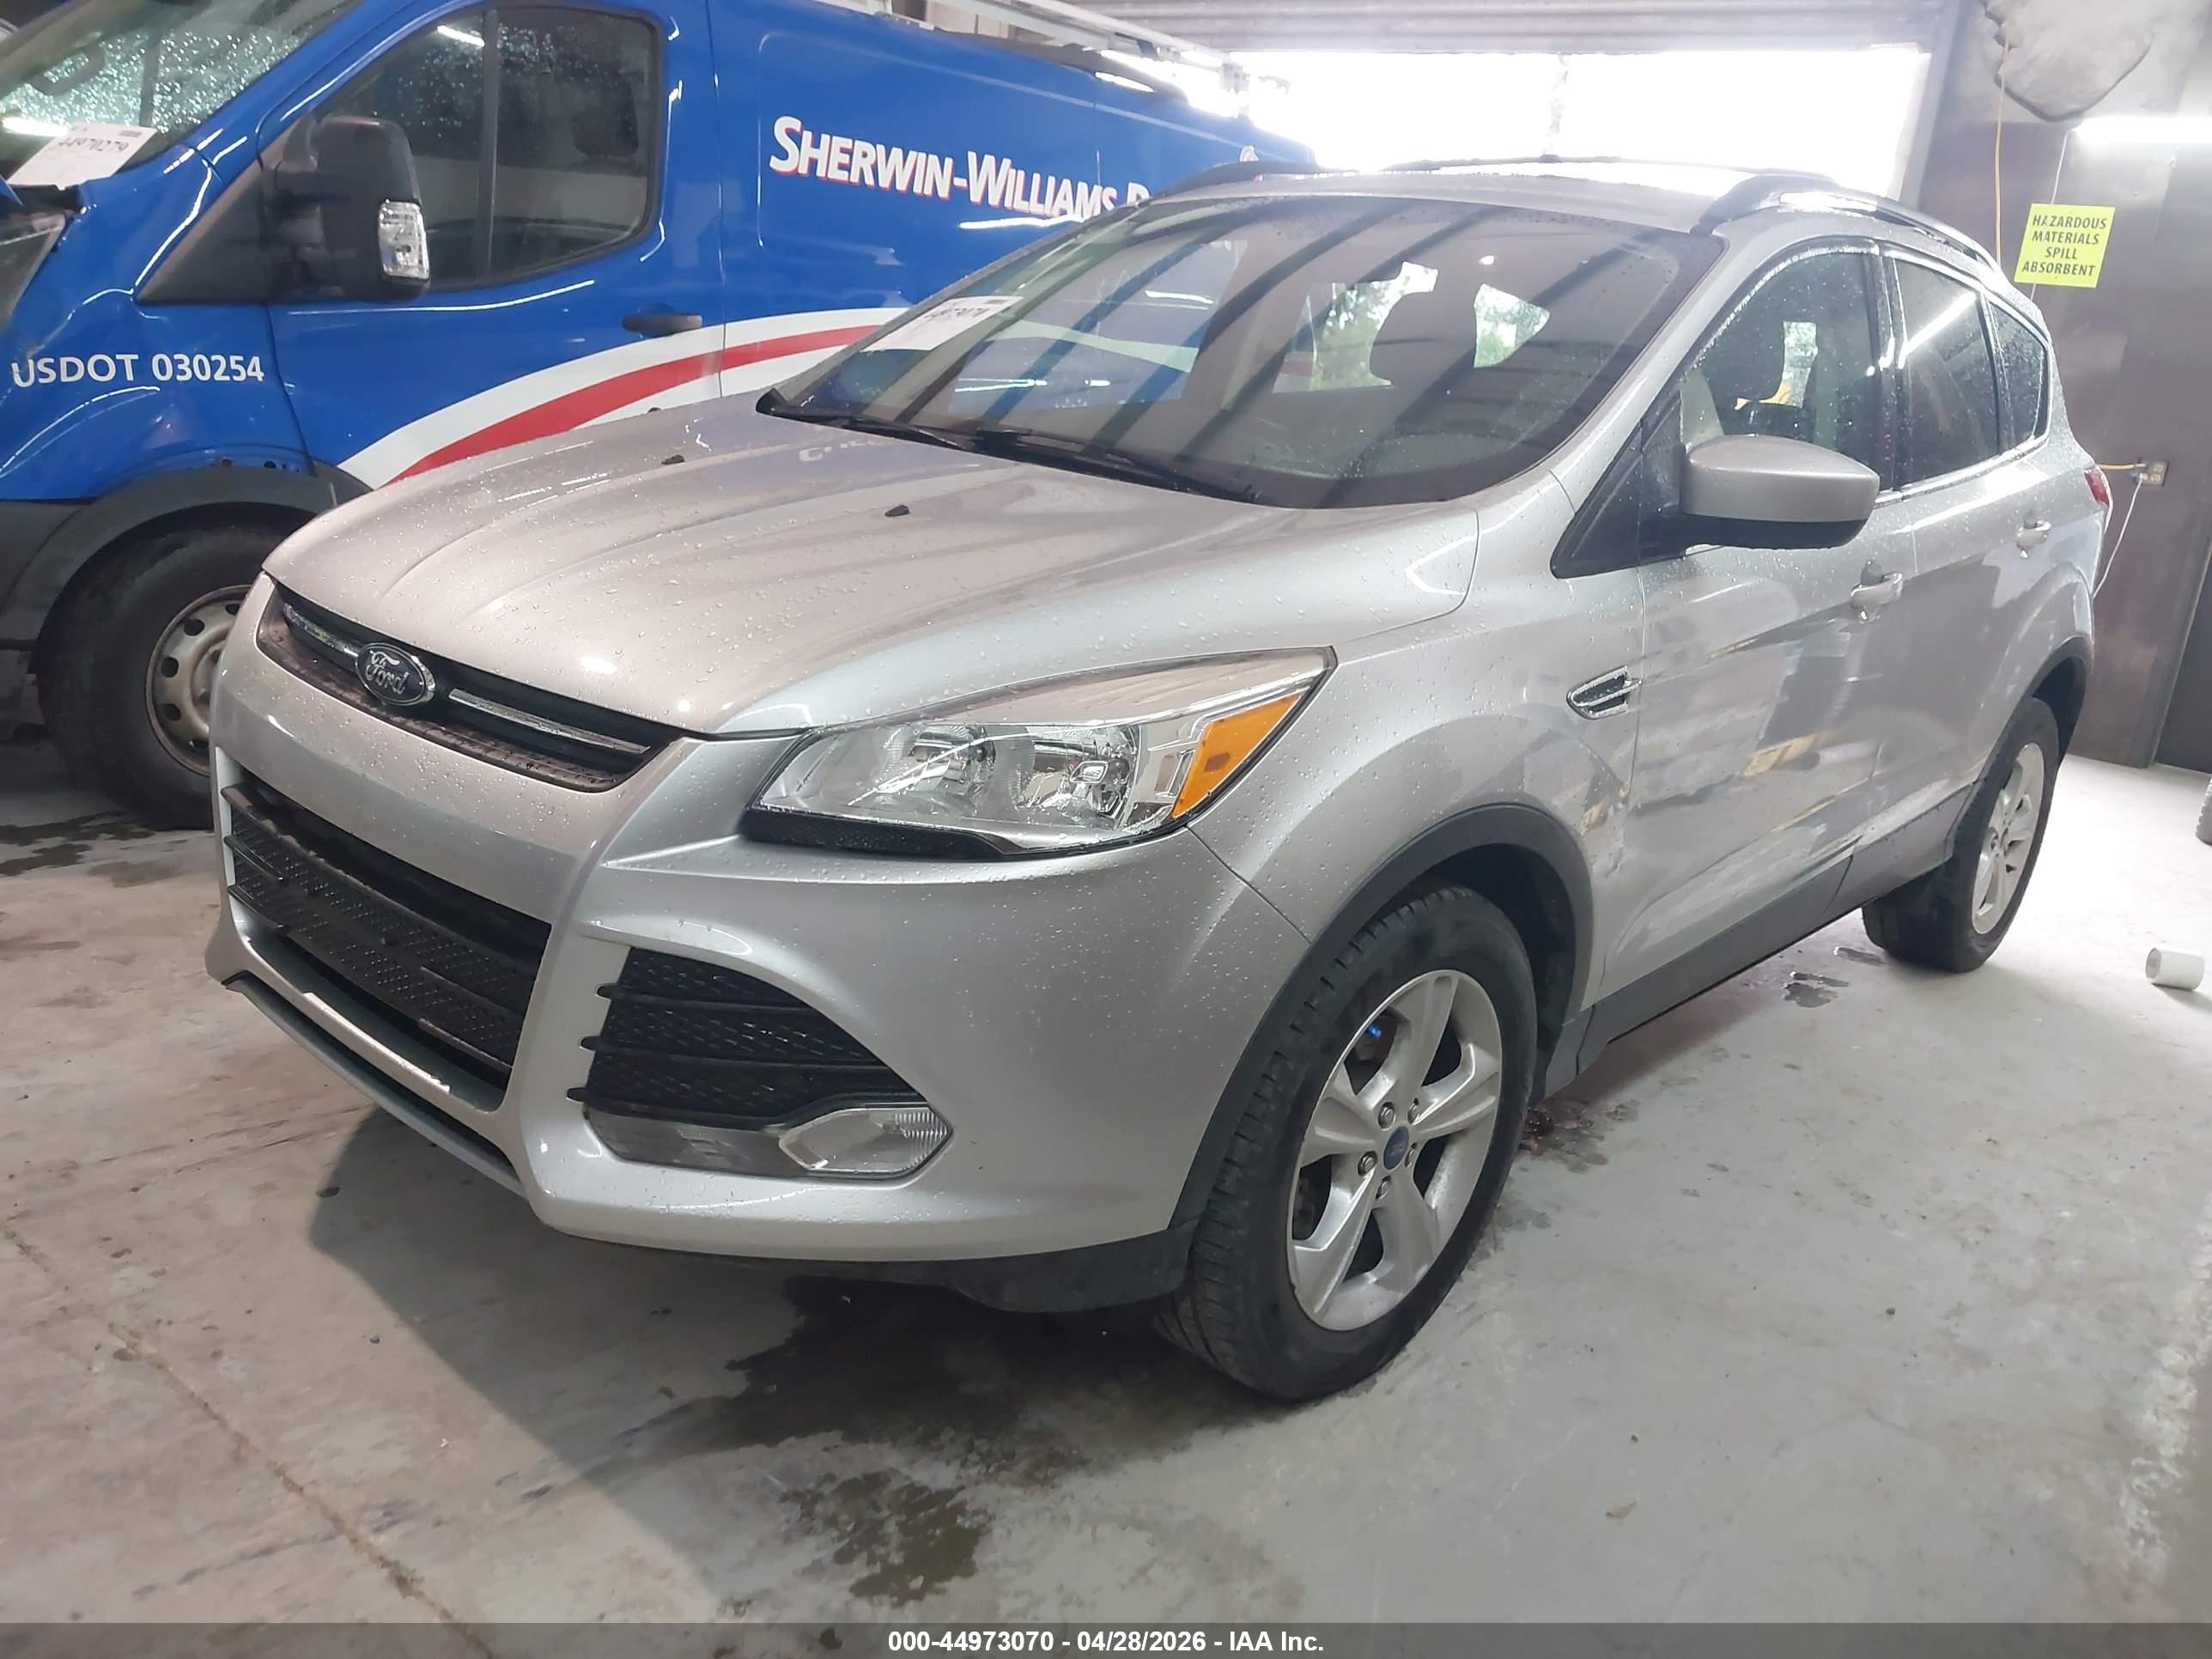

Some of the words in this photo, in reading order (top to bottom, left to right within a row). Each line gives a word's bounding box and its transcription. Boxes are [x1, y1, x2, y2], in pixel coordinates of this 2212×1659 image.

[769, 116, 1118, 220] SHERWIN-WILLIAMS
[2032, 215, 2108, 229] HAZARDOUS
[2032, 230, 2100, 245] MATERIALS
[2045, 246, 2078, 259] SPILL
[2021, 261, 2096, 276] ABSORBENT
[10, 354, 139, 388] USDOT
[152, 354, 265, 381] 030254
[366, 650, 410, 695] Ford
